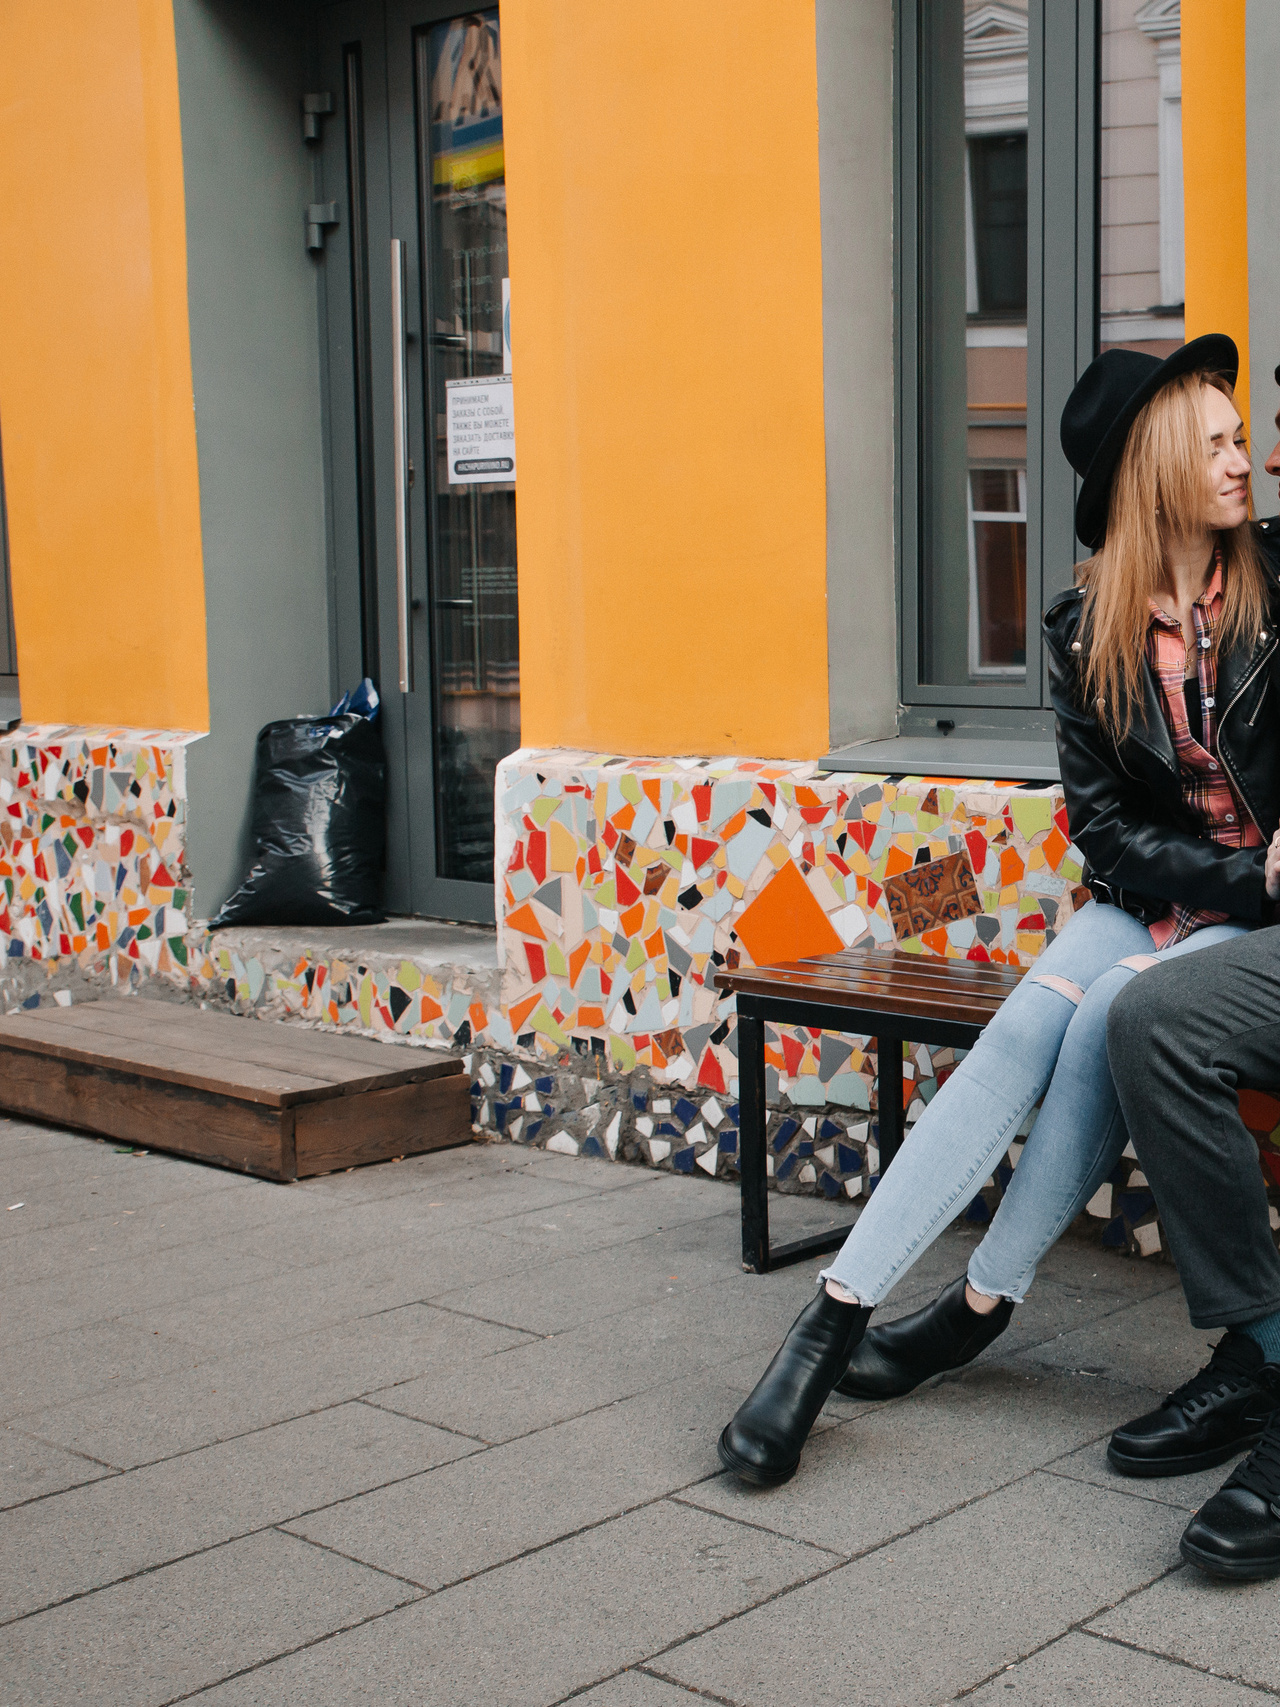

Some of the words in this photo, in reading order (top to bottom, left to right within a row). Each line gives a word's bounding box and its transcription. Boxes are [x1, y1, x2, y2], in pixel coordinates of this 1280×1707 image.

[452, 395, 489, 405] ПРИНИМАЕМ
[452, 407, 476, 418] ЗАКАЗЫ
[452, 421, 472, 431] ТАКЖЕ
[473, 420, 483, 429] ВЫ
[484, 418, 510, 428] МОЖЕТЕ
[453, 433, 482, 444] ЗАКАЗАТЬ
[453, 446, 461, 456] НА
[462, 444, 480, 455] САЙТЕ
